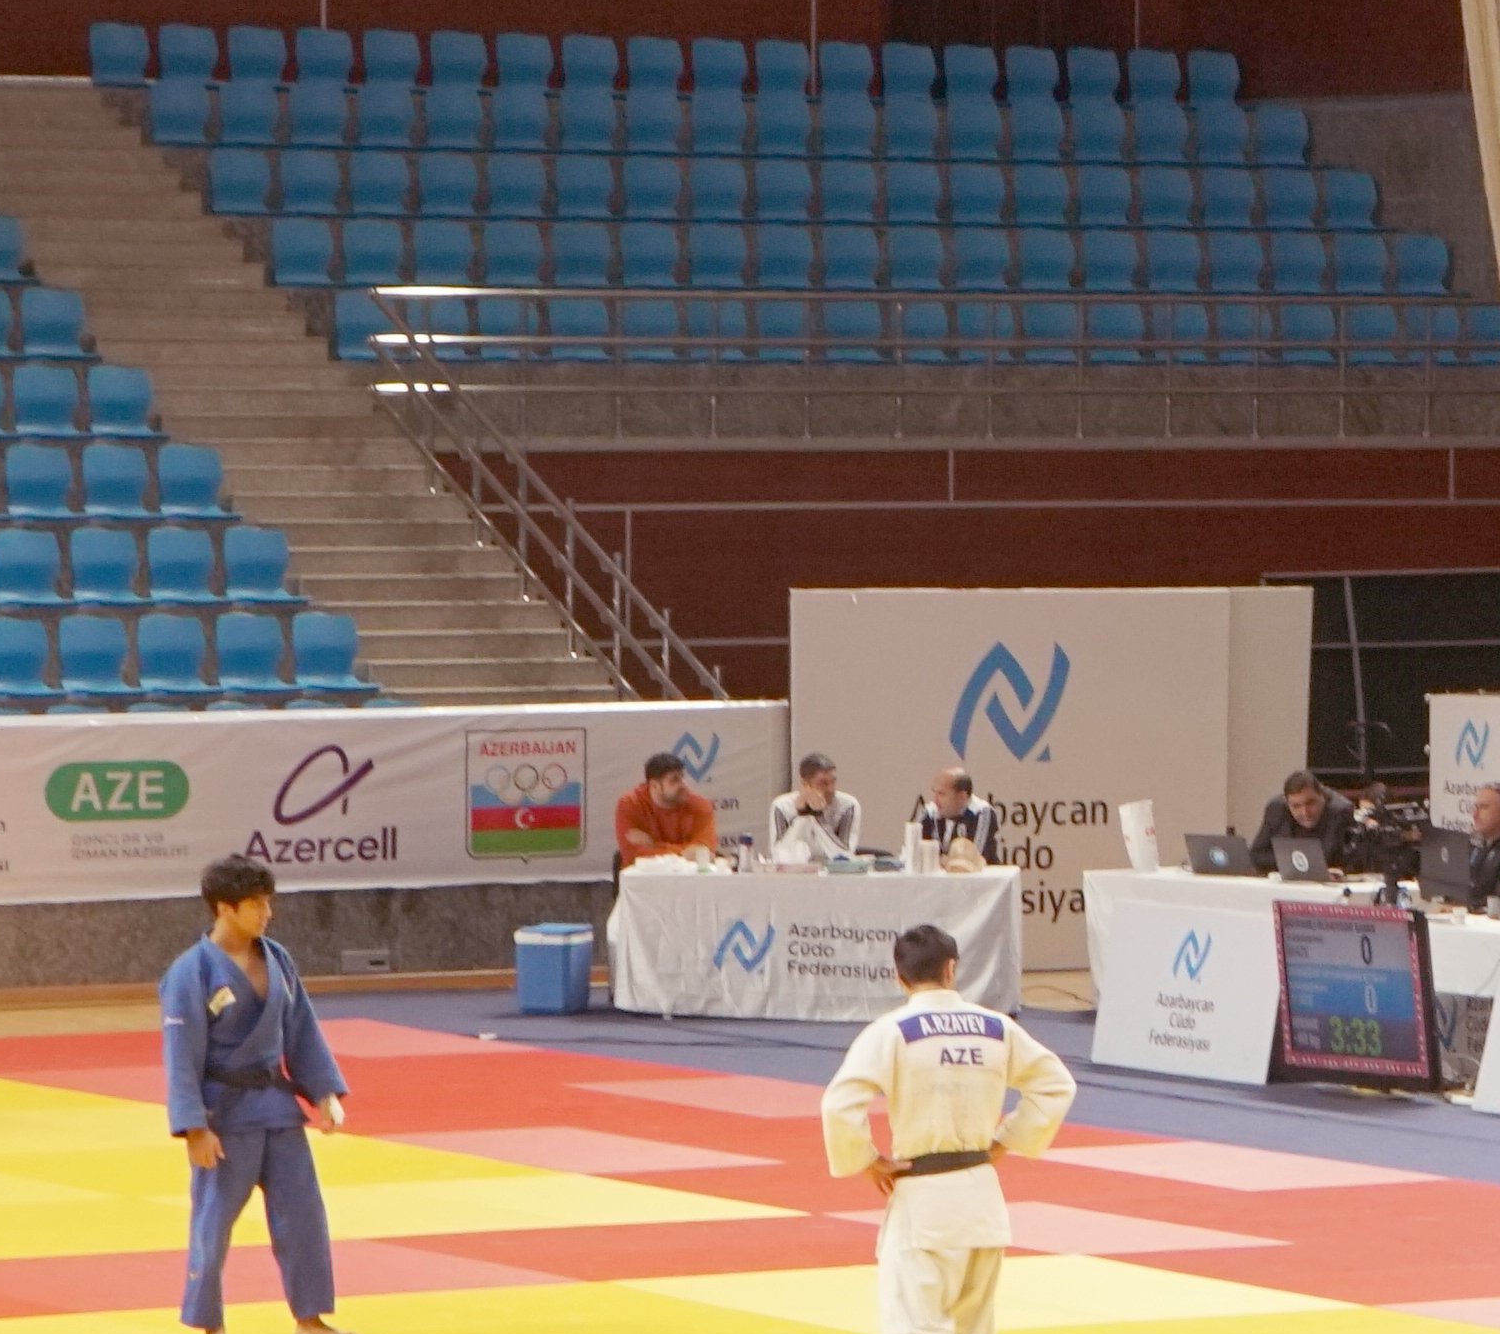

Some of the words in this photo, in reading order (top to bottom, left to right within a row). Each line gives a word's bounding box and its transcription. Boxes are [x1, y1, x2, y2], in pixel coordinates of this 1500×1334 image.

[479, 739, 577, 758] AZERBAIJAN
[70, 770, 165, 811] AZE
[244, 825, 398, 865] Azercell
[1361, 934, 1372, 965] 0
[1364, 984, 1377, 1014] 0
[1329, 1016, 1382, 1055] 3:33
[939, 1047, 983, 1066] AZE
